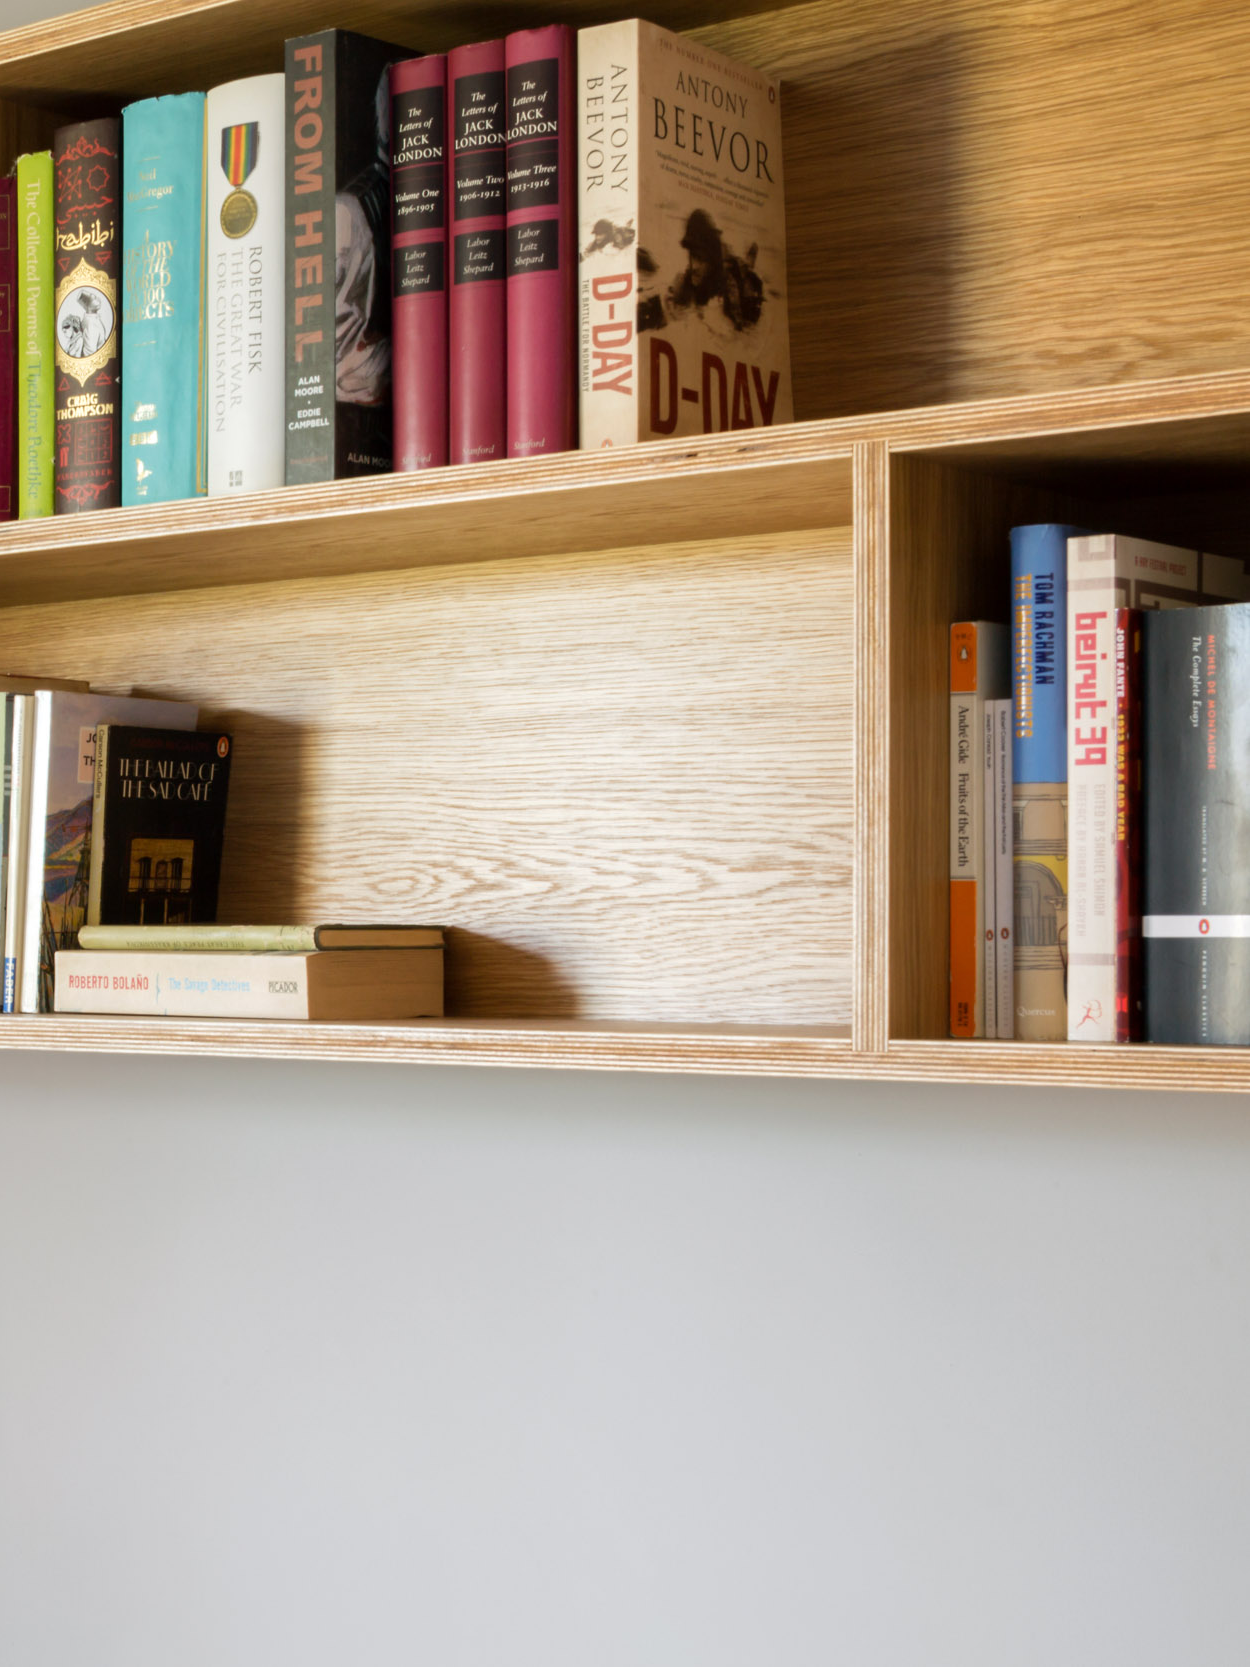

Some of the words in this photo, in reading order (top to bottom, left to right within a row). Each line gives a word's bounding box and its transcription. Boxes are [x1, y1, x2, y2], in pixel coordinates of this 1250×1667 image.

[522, 80, 536, 92] The
[676, 70, 748, 118] ANTONY
[470, 92, 486, 102] The
[512, 93, 536, 108] Letters
[538, 90, 548, 102] of
[294, 44, 324, 196] FROM
[408, 107, 422, 118] The
[462, 104, 486, 118] Letters
[488, 102, 499, 114] of
[515, 107, 544, 124] JACK
[399, 119, 422, 133] Letters
[423, 117, 434, 129] of
[464, 118, 494, 136] JACK
[507, 120, 558, 140] LONDON
[586, 76, 604, 192] BEEVOR
[610, 64, 629, 193] ANTONY
[402, 134, 430, 151] JACK
[454, 132, 507, 150] LONDON
[652, 96, 775, 184] BEEVOR
[393, 146, 442, 166] LONDON
[456, 176, 484, 190] Volume
[486, 174, 505, 184] Two
[507, 166, 532, 180] Volume
[533, 164, 557, 174] Three
[26, 179, 41, 210] The
[395, 190, 420, 204] Volume
[422, 188, 440, 199] One
[459, 190, 500, 202] 1906-1912
[510, 178, 550, 194] 1913-1916
[397, 203, 436, 216] 1896-1905
[55, 218, 114, 252] habibi
[466, 236, 490, 248] Labor
[517, 228, 541, 240] Labor
[26, 211, 41, 282] Collected
[404, 250, 426, 261] Labor
[468, 250, 488, 261] Leitz
[519, 242, 538, 253] Leitz
[231, 246, 244, 288] THE
[406, 262, 424, 274] Leitz
[462, 262, 494, 276] Shepard
[514, 254, 544, 267] Shepard
[216, 252, 227, 292] FOR
[401, 274, 430, 288] Shepard
[248, 245, 263, 324] ROBERT
[294, 210, 324, 363] HELL
[27, 286, 42, 338] Poems
[230, 293, 243, 356] GREAT
[592, 272, 634, 396] D-DAY
[26, 340, 42, 356] of
[248, 332, 263, 374] FISK
[215, 296, 227, 432] CIVILISATION
[230, 361, 243, 408] WAR
[298, 374, 320, 386] ALAN
[650, 336, 780, 436] D-DAY
[26, 360, 42, 433] Theodore
[66, 392, 99, 408] CRAIG
[294, 385, 324, 398] MOORE
[56, 403, 114, 421] THOMPSON
[297, 407, 321, 419] EDDIE
[288, 417, 330, 431] CAMPBELL
[26, 436, 42, 500] Roethke
[1014, 573, 1034, 600] THE
[1034, 572, 1054, 604] TOM
[1034, 610, 1054, 686] RACHMAN
[1116, 628, 1125, 658] JOHN
[1192, 636, 1202, 651] The
[1207, 634, 1216, 676] MICHEL
[1015, 604, 1034, 739] IMPERFECTIONISTS
[1074, 611, 1108, 720] beirut
[1116, 662, 1125, 698] FANTE
[1190, 655, 1202, 697] Complete
[1207, 682, 1216, 695] DE
[958, 705, 970, 738] André
[1190, 700, 1201, 728] Essays
[1117, 714, 1125, 741] 1933
[1207, 700, 1216, 770] MONTAIGNE
[958, 740, 970, 764] Gide
[1074, 726, 1108, 766] 39
[1117, 744, 1125, 768] WAS
[96, 760, 104, 799] McCullers
[120, 758, 143, 778] THE
[144, 759, 197, 780] BALLAD
[198, 762, 220, 782] OF
[1117, 772, 1125, 782] A
[122, 780, 145, 798] THE
[149, 780, 175, 800] SAD
[958, 772, 970, 802] Fruits
[1117, 784, 1125, 808] BAD
[958, 804, 970, 816] of
[958, 818, 970, 832] the
[1116, 812, 1125, 841] YEAR
[958, 836, 970, 867] Earth
[68, 974, 109, 990] ROBERTO
[112, 973, 150, 990] BOLAÑO
[168, 976, 182, 990] The
[184, 978, 208, 994] Savage
[211, 978, 251, 992] Detectives
[268, 980, 299, 994] PICADOR
[1016, 1006, 1056, 1018] Quercus
